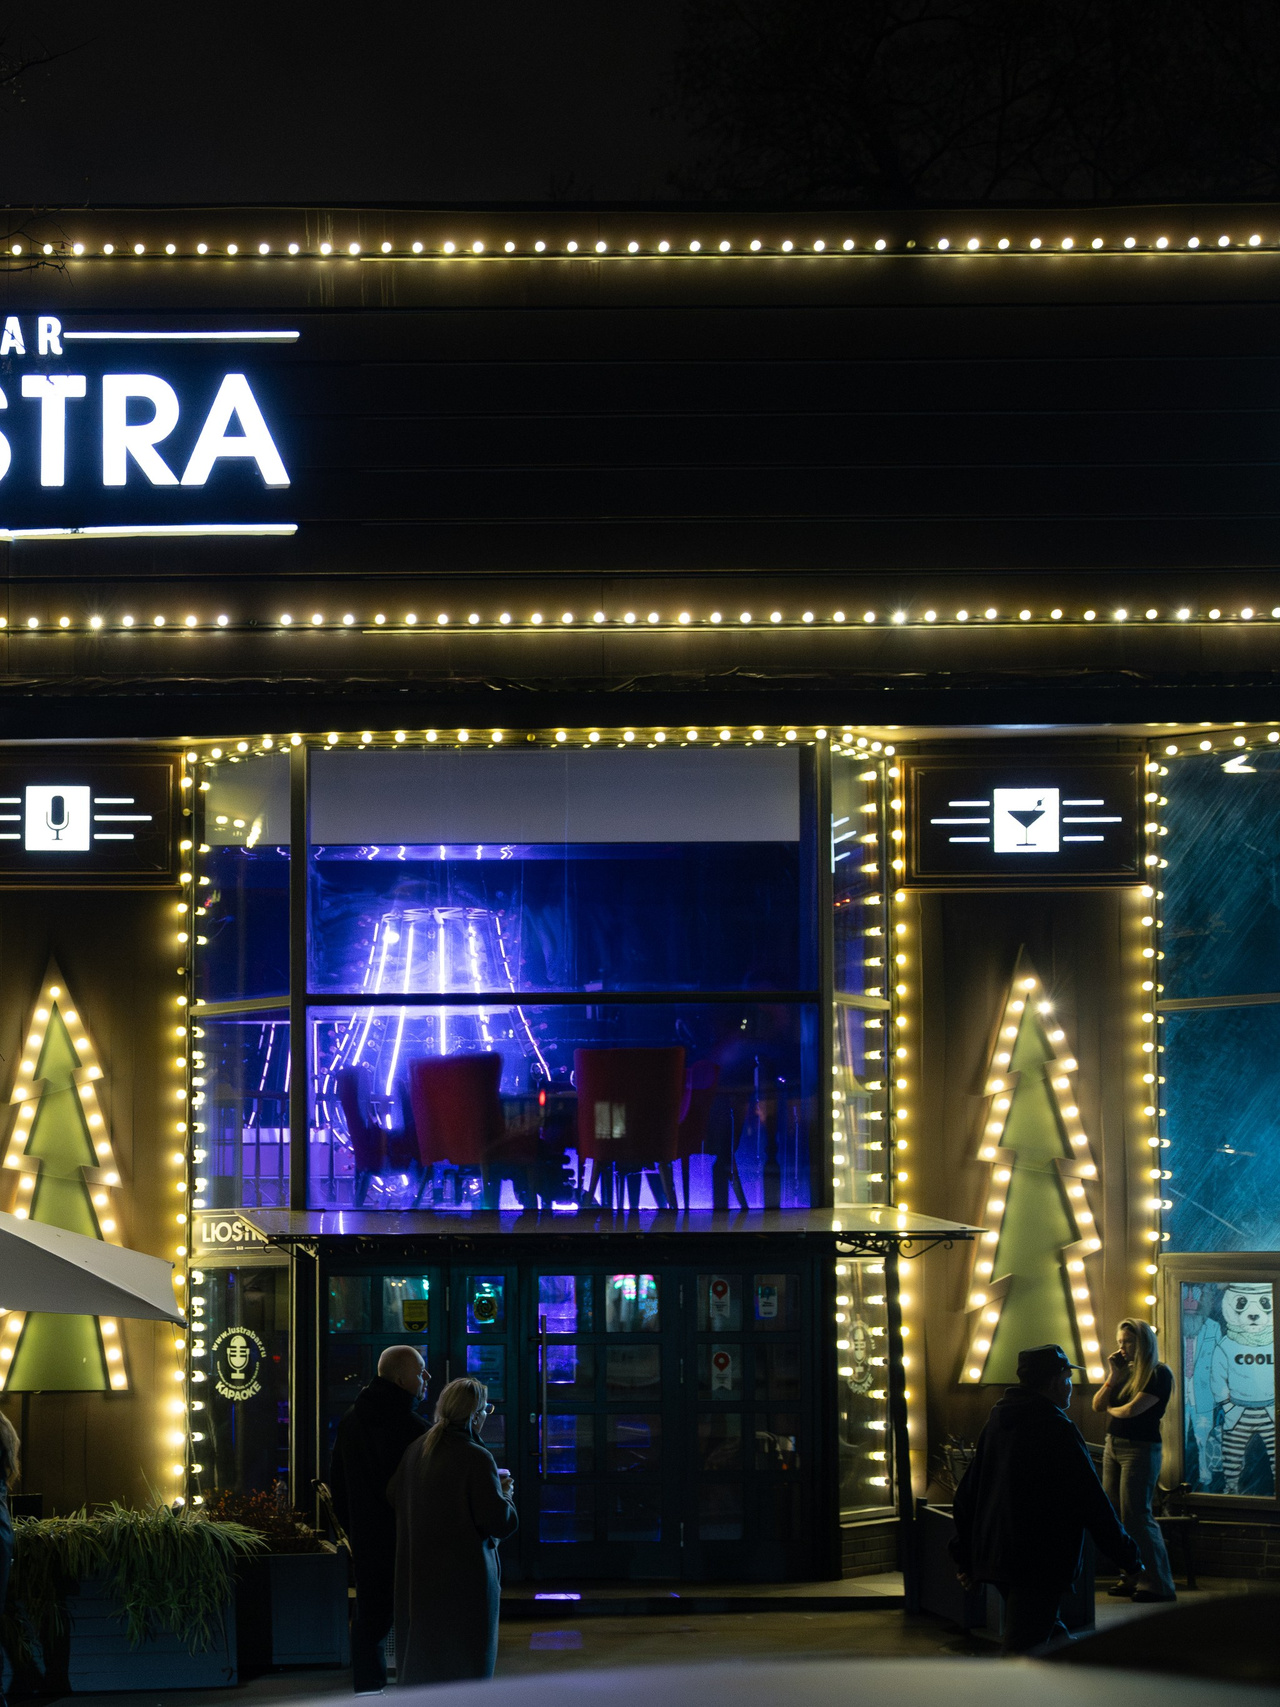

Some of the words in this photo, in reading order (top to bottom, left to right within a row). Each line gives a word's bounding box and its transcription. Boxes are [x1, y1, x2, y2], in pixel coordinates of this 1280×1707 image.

[211, 1326, 267, 1358] www.lustrabar.ru
[1234, 1353, 1274, 1365] COOL
[215, 1380, 262, 1401] КАРАОКЕ
